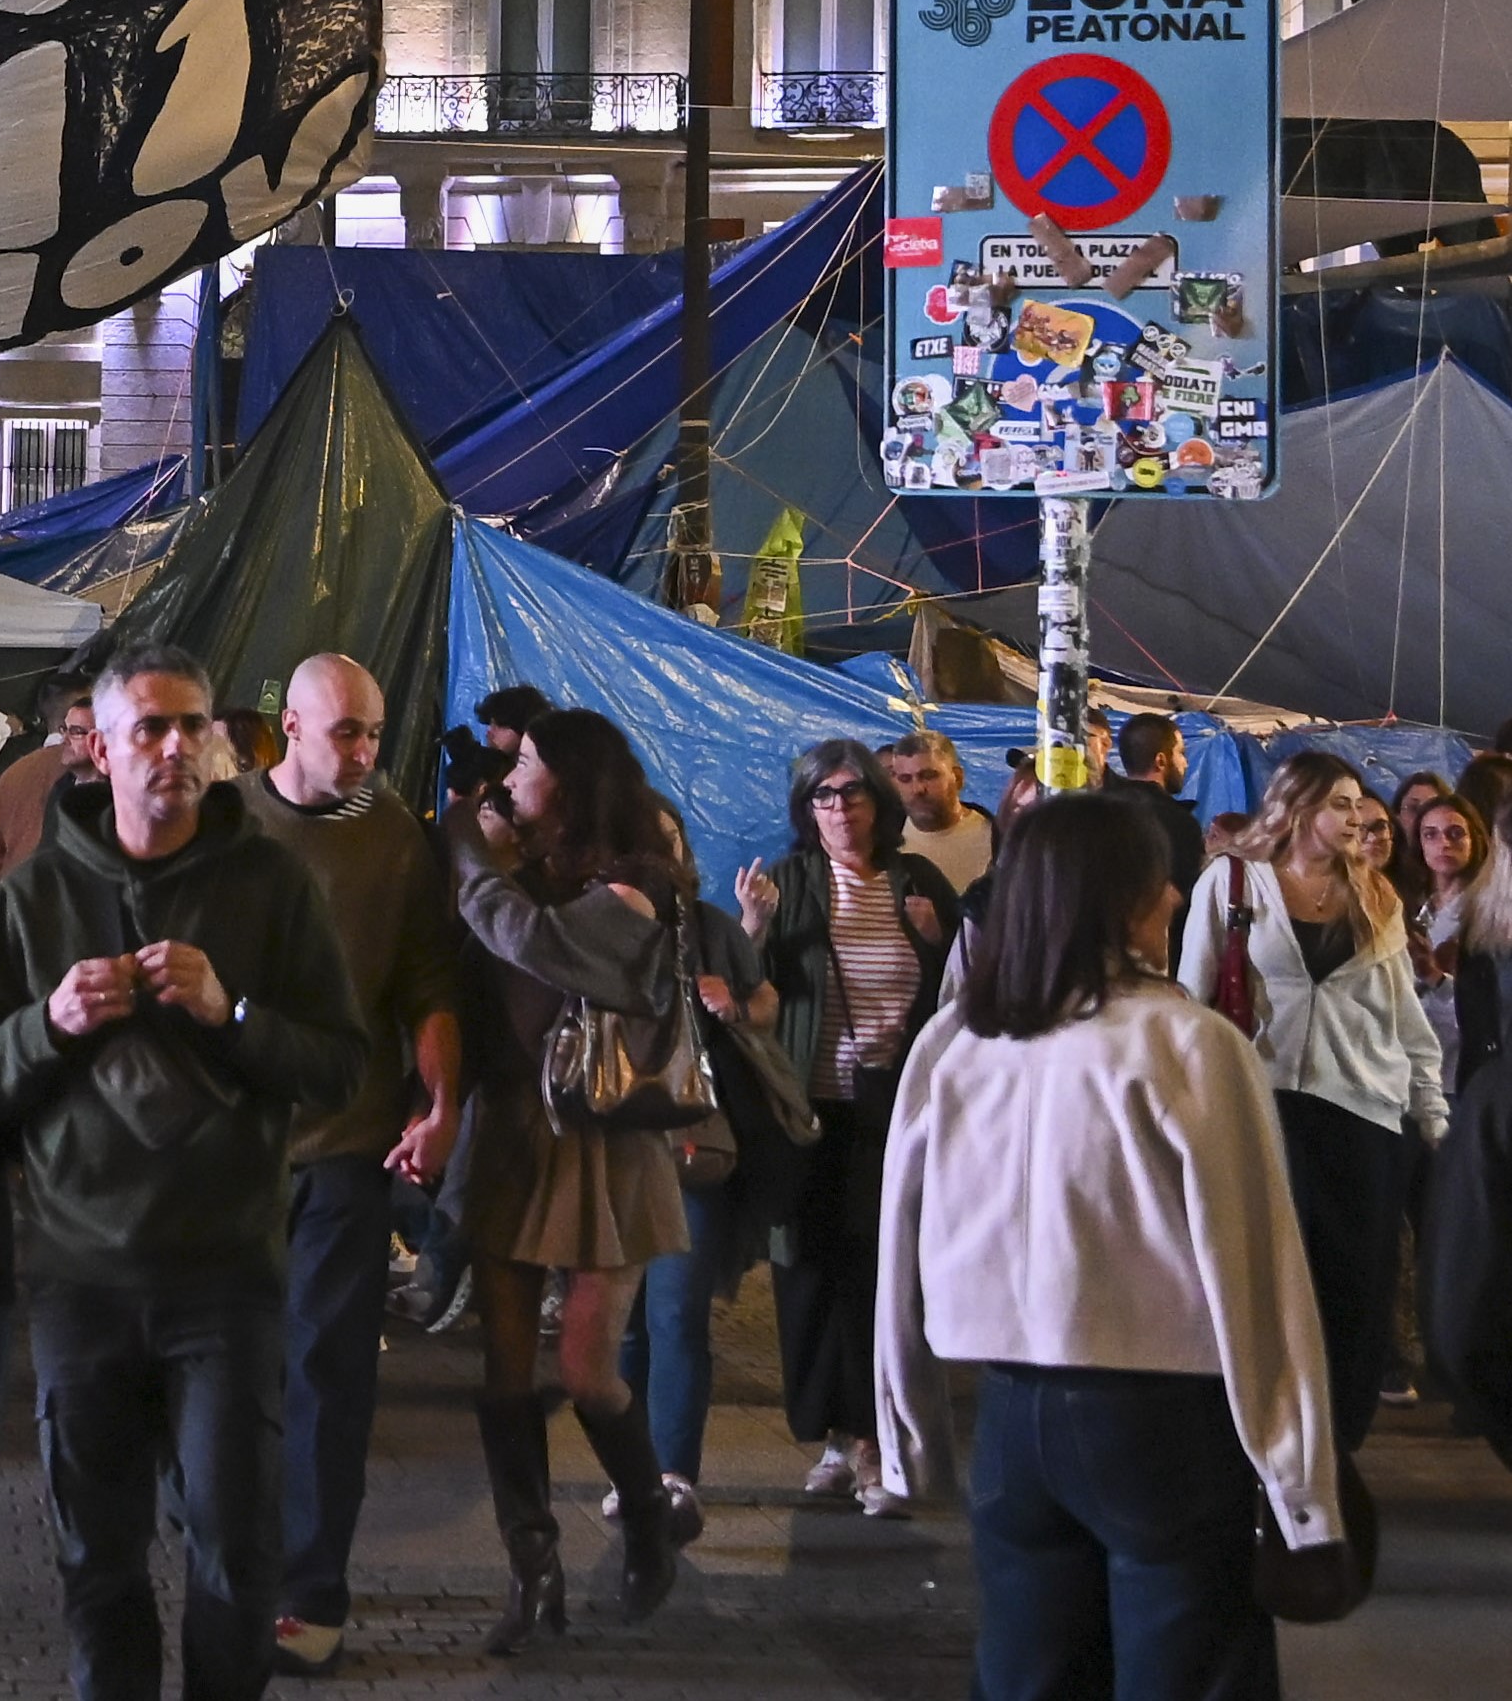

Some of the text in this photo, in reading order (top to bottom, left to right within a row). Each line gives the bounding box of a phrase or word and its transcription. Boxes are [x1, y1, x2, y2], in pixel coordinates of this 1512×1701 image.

[1027, 13, 1246, 42] PEATONAL
[990, 244, 1012, 258] EN
[915, 339, 948, 358] ETXE
[1165, 374, 1217, 393] ODIATI
[1174, 389, 1215, 405] FIERE
